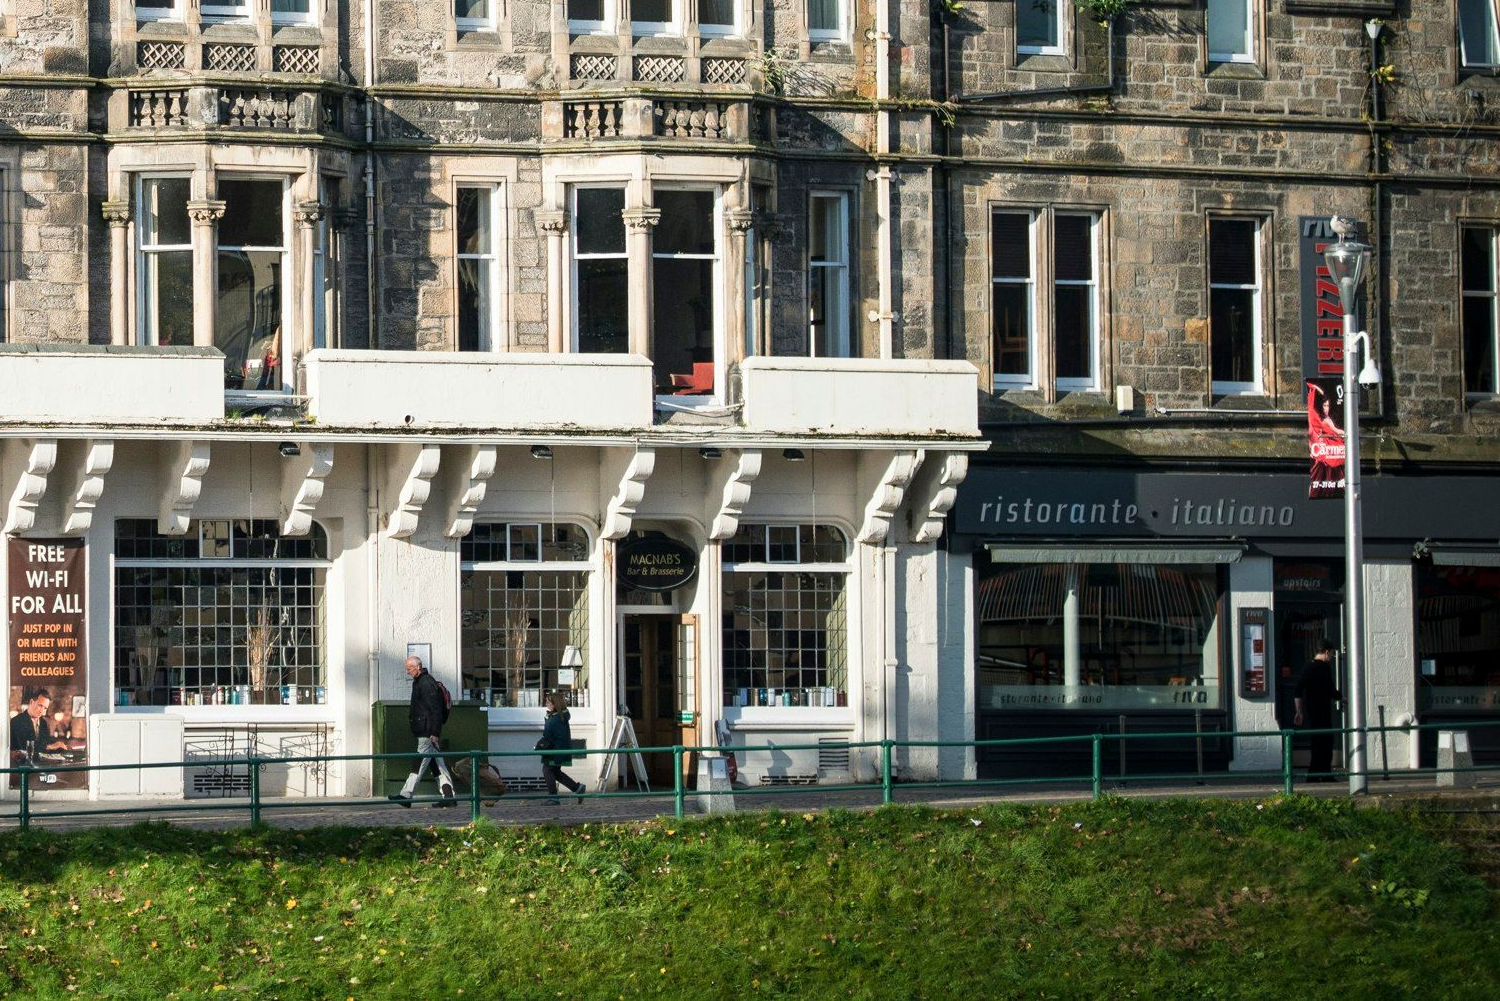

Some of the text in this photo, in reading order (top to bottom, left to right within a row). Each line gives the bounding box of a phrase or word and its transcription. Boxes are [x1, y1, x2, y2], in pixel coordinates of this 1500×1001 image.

[980, 496, 1295, 526] ristorante italiano
[28, 544, 66, 563] FREE
[630, 553, 681, 565] MACNAB'S
[627, 567, 640, 576] Bar
[650, 567, 685, 576] Brasserie
[25, 570, 68, 589] WI-FI
[1283, 577, 1322, 588] upstairs
[12, 594, 82, 614] FOR ALL
[22, 623, 73, 634] JUST POP IN
[17, 637, 78, 648] OR MEET WITH
[19, 652, 76, 662] FRIENDS AND
[21, 666, 75, 677] COLLEAGUES
